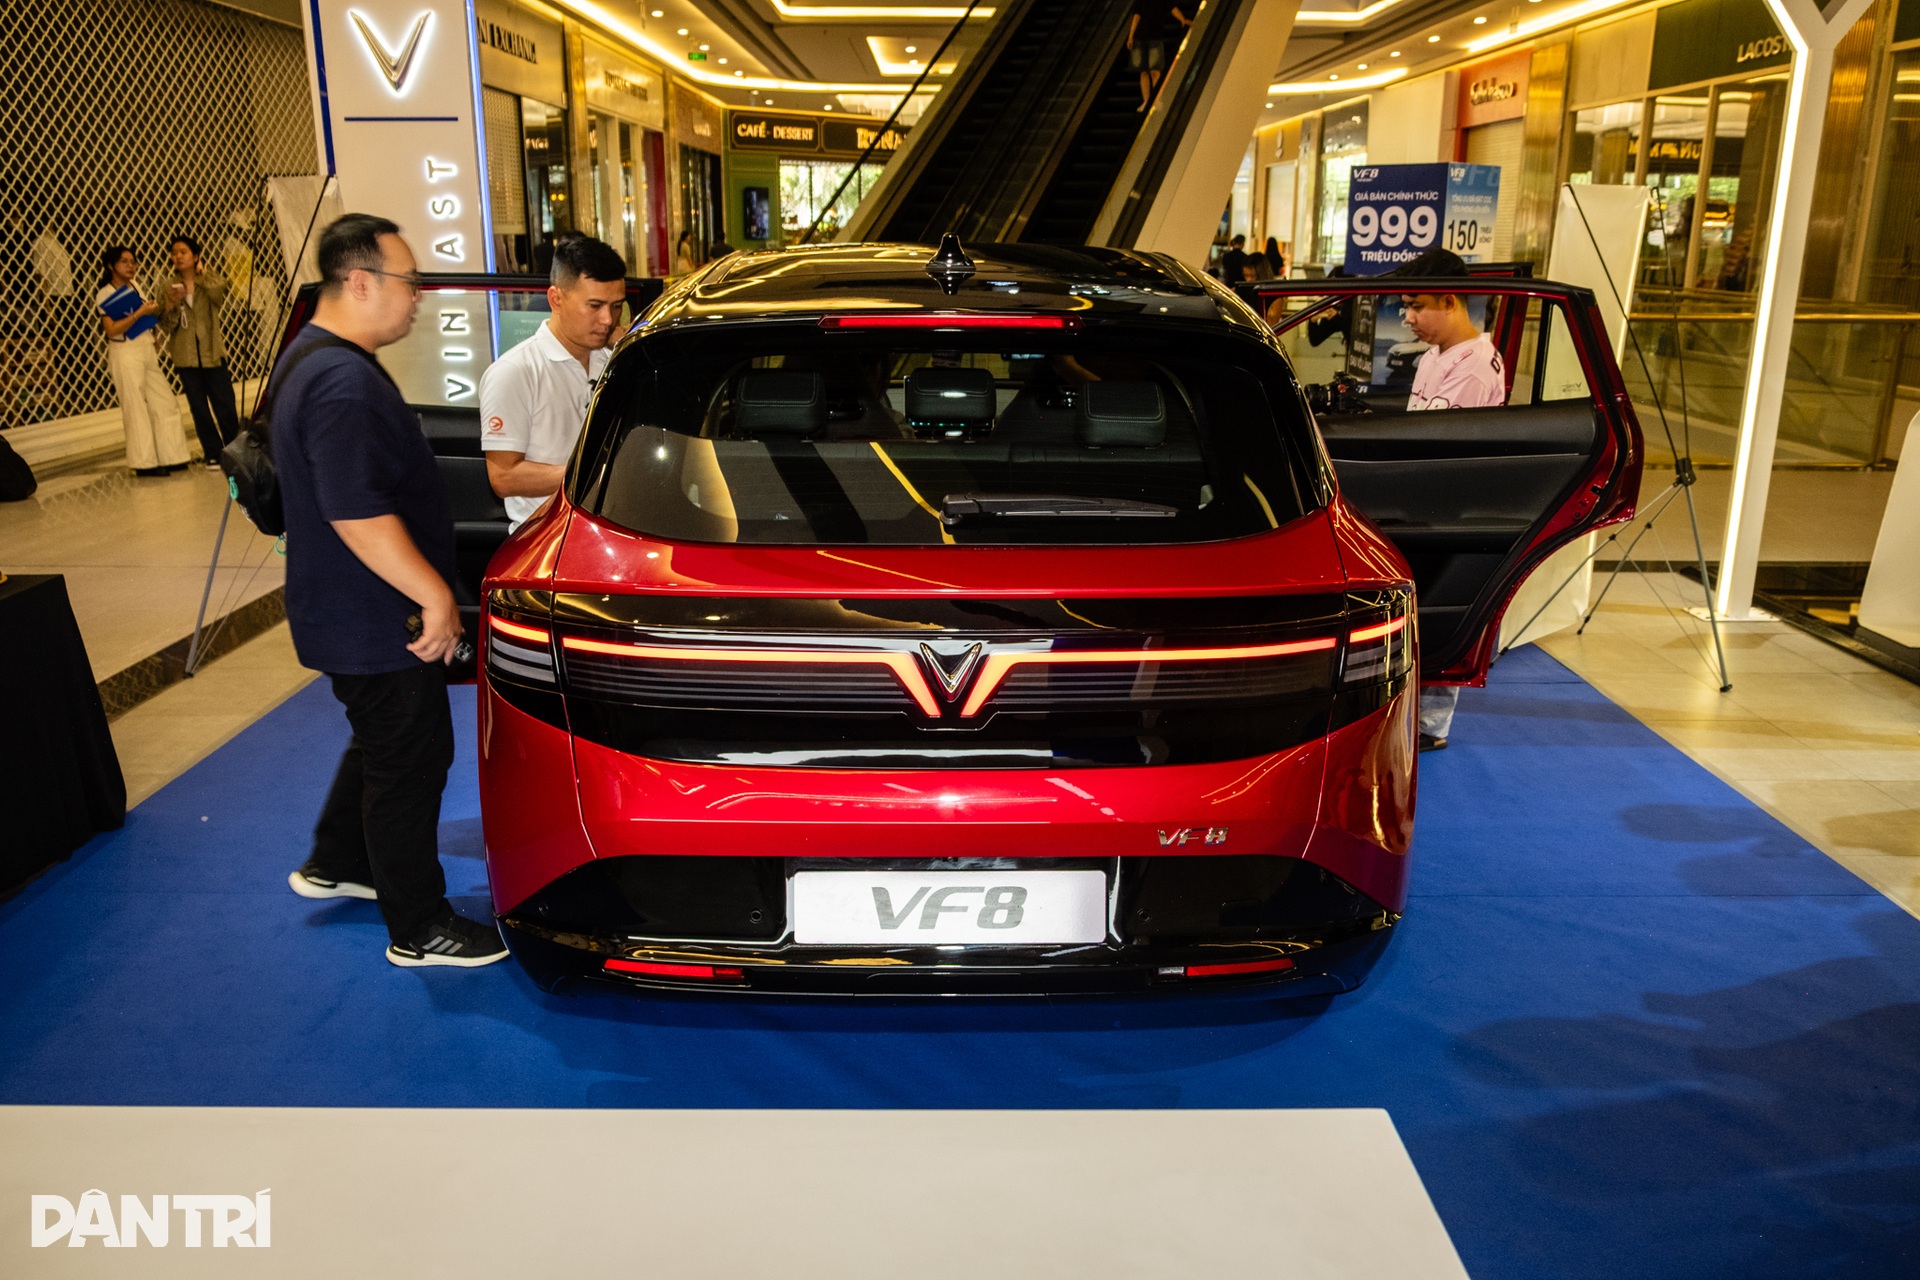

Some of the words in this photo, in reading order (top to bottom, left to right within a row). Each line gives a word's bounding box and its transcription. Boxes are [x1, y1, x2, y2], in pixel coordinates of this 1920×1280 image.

[1737, 35, 1791, 63] LACOST
[737, 121, 767, 139] CAFÉ
[773, 125, 814, 141] DESSERT
[1353, 168, 1379, 179] VF8
[1450, 167, 1466, 178] VF8
[1354, 190, 1369, 201] GIÁ
[1369, 190, 1386, 201] BÁN
[1387, 190, 1414, 201] CHÍNH
[1415, 190, 1439, 201] THỨC
[1352, 205, 1438, 248] 999
[1448, 219, 1478, 250] 150
[1360, 249, 1391, 264] TRIỆU
[426, 158, 473, 400] VINAST
[1157, 826, 1230, 848] VF8
[870, 885, 1029, 931] VF8
